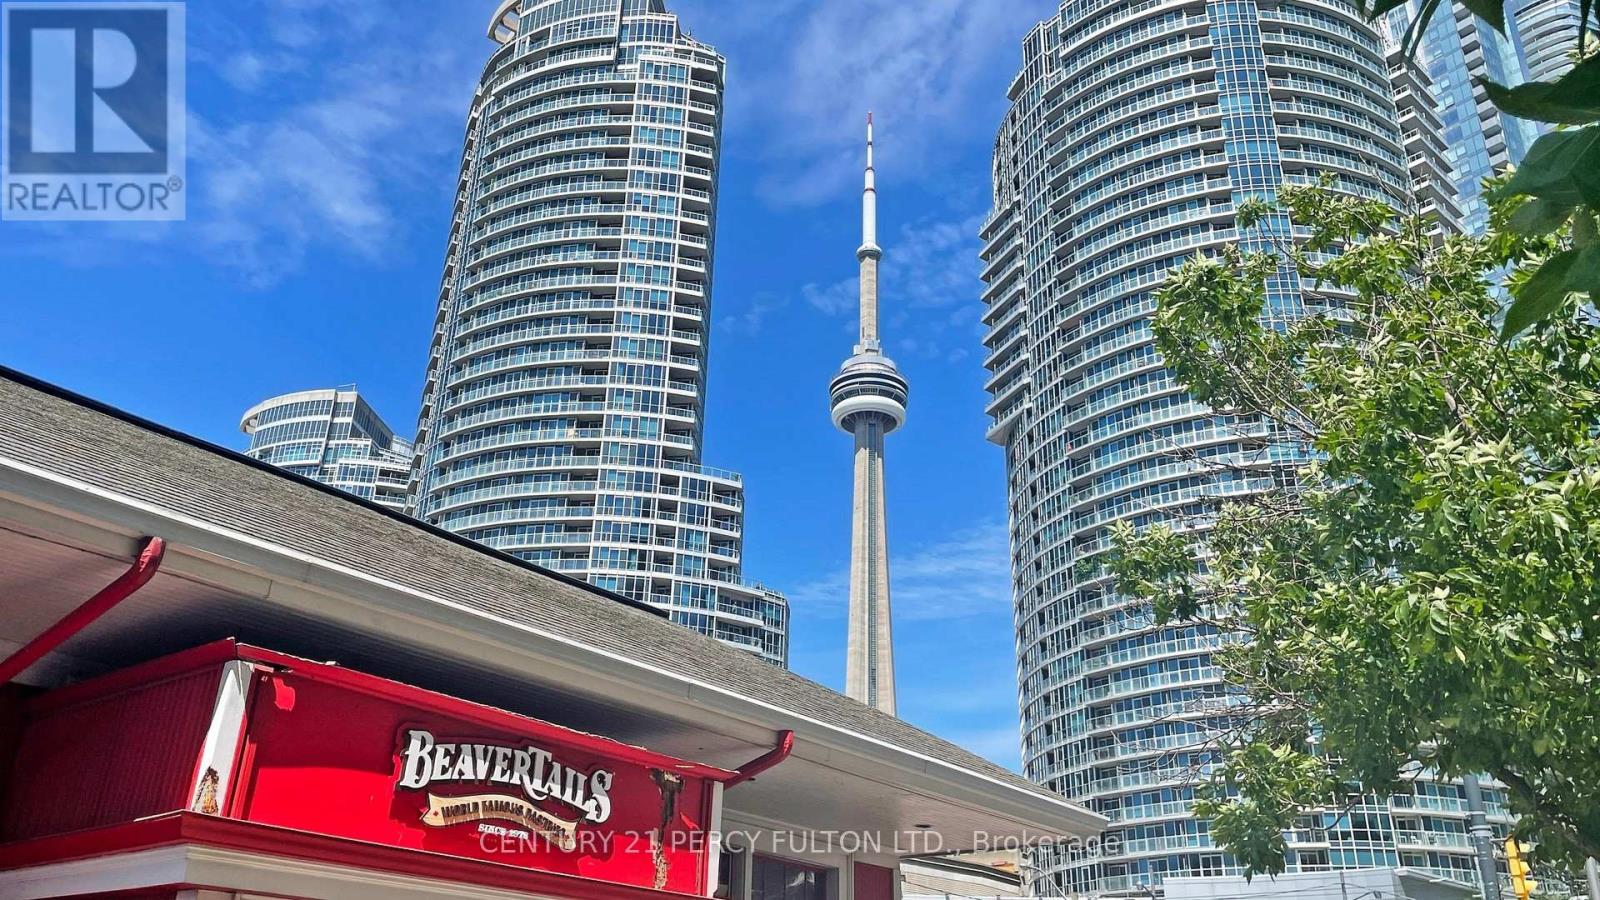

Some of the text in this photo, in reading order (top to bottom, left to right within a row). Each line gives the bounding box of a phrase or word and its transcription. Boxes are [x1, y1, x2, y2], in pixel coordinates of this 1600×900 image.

[478, 823, 529, 840] SINCE 1978
[481, 800, 524, 816] FAMOUS
[525, 807, 566, 837] PASTRIES
